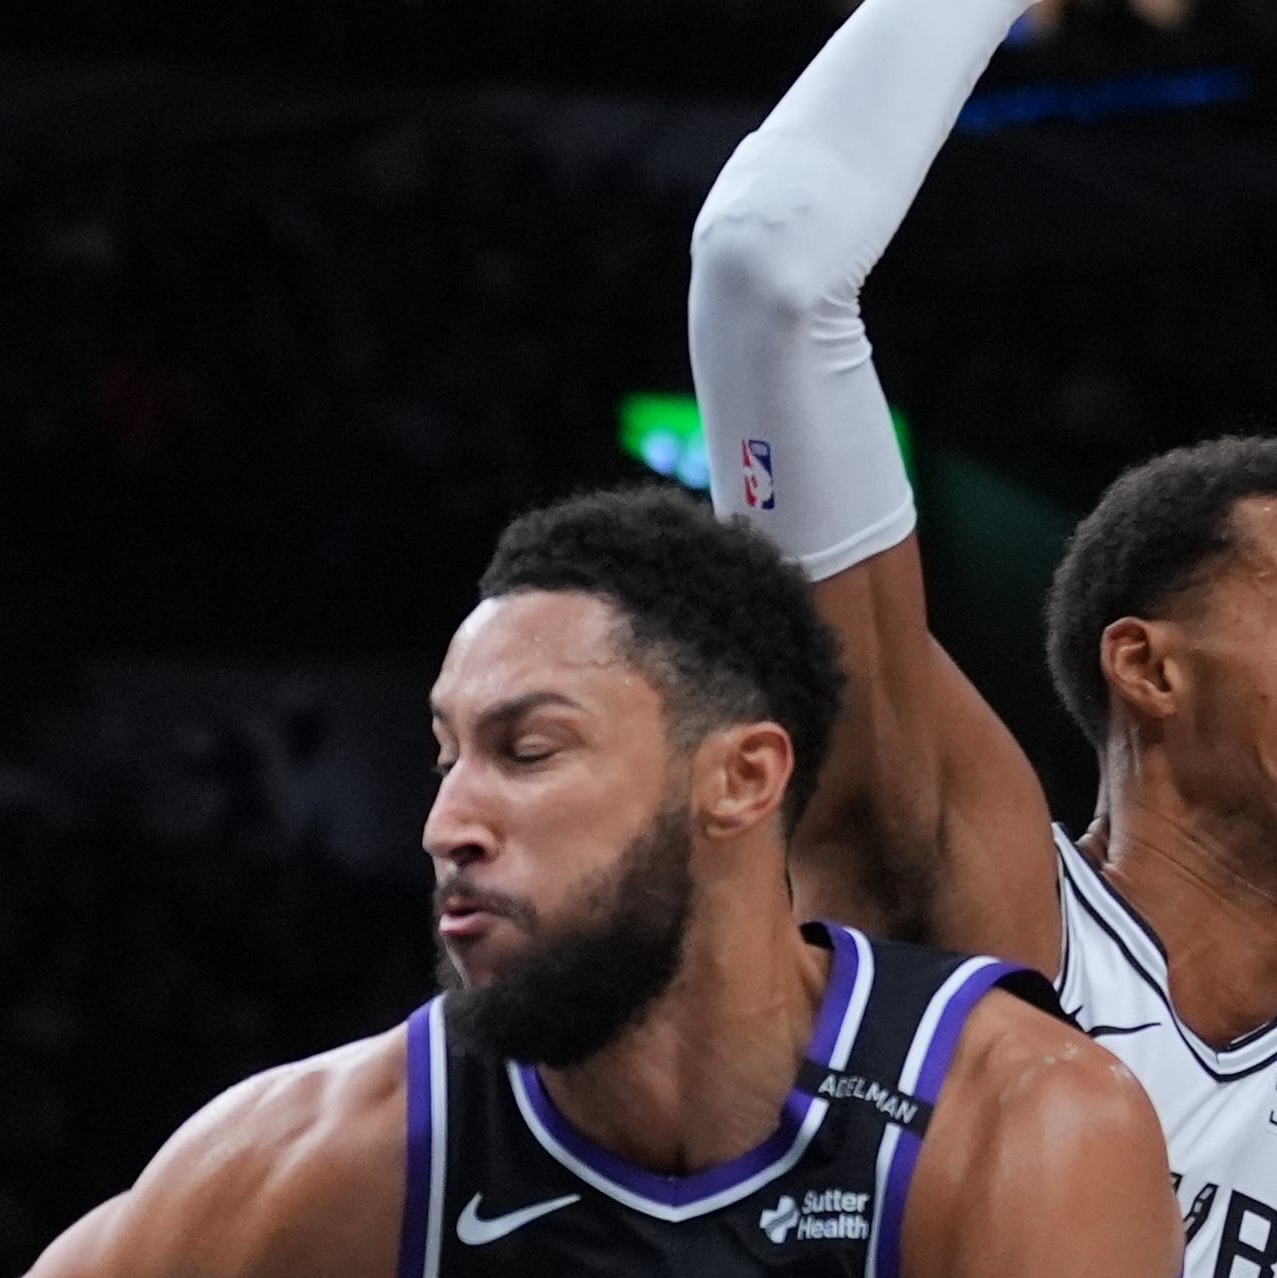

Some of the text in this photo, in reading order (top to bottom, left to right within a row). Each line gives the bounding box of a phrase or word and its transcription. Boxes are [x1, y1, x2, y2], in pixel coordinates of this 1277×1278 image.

[818, 1073, 919, 1124] ADELMAN
[802, 1188, 870, 1215] Sutter
[797, 1214, 869, 1241] Health
